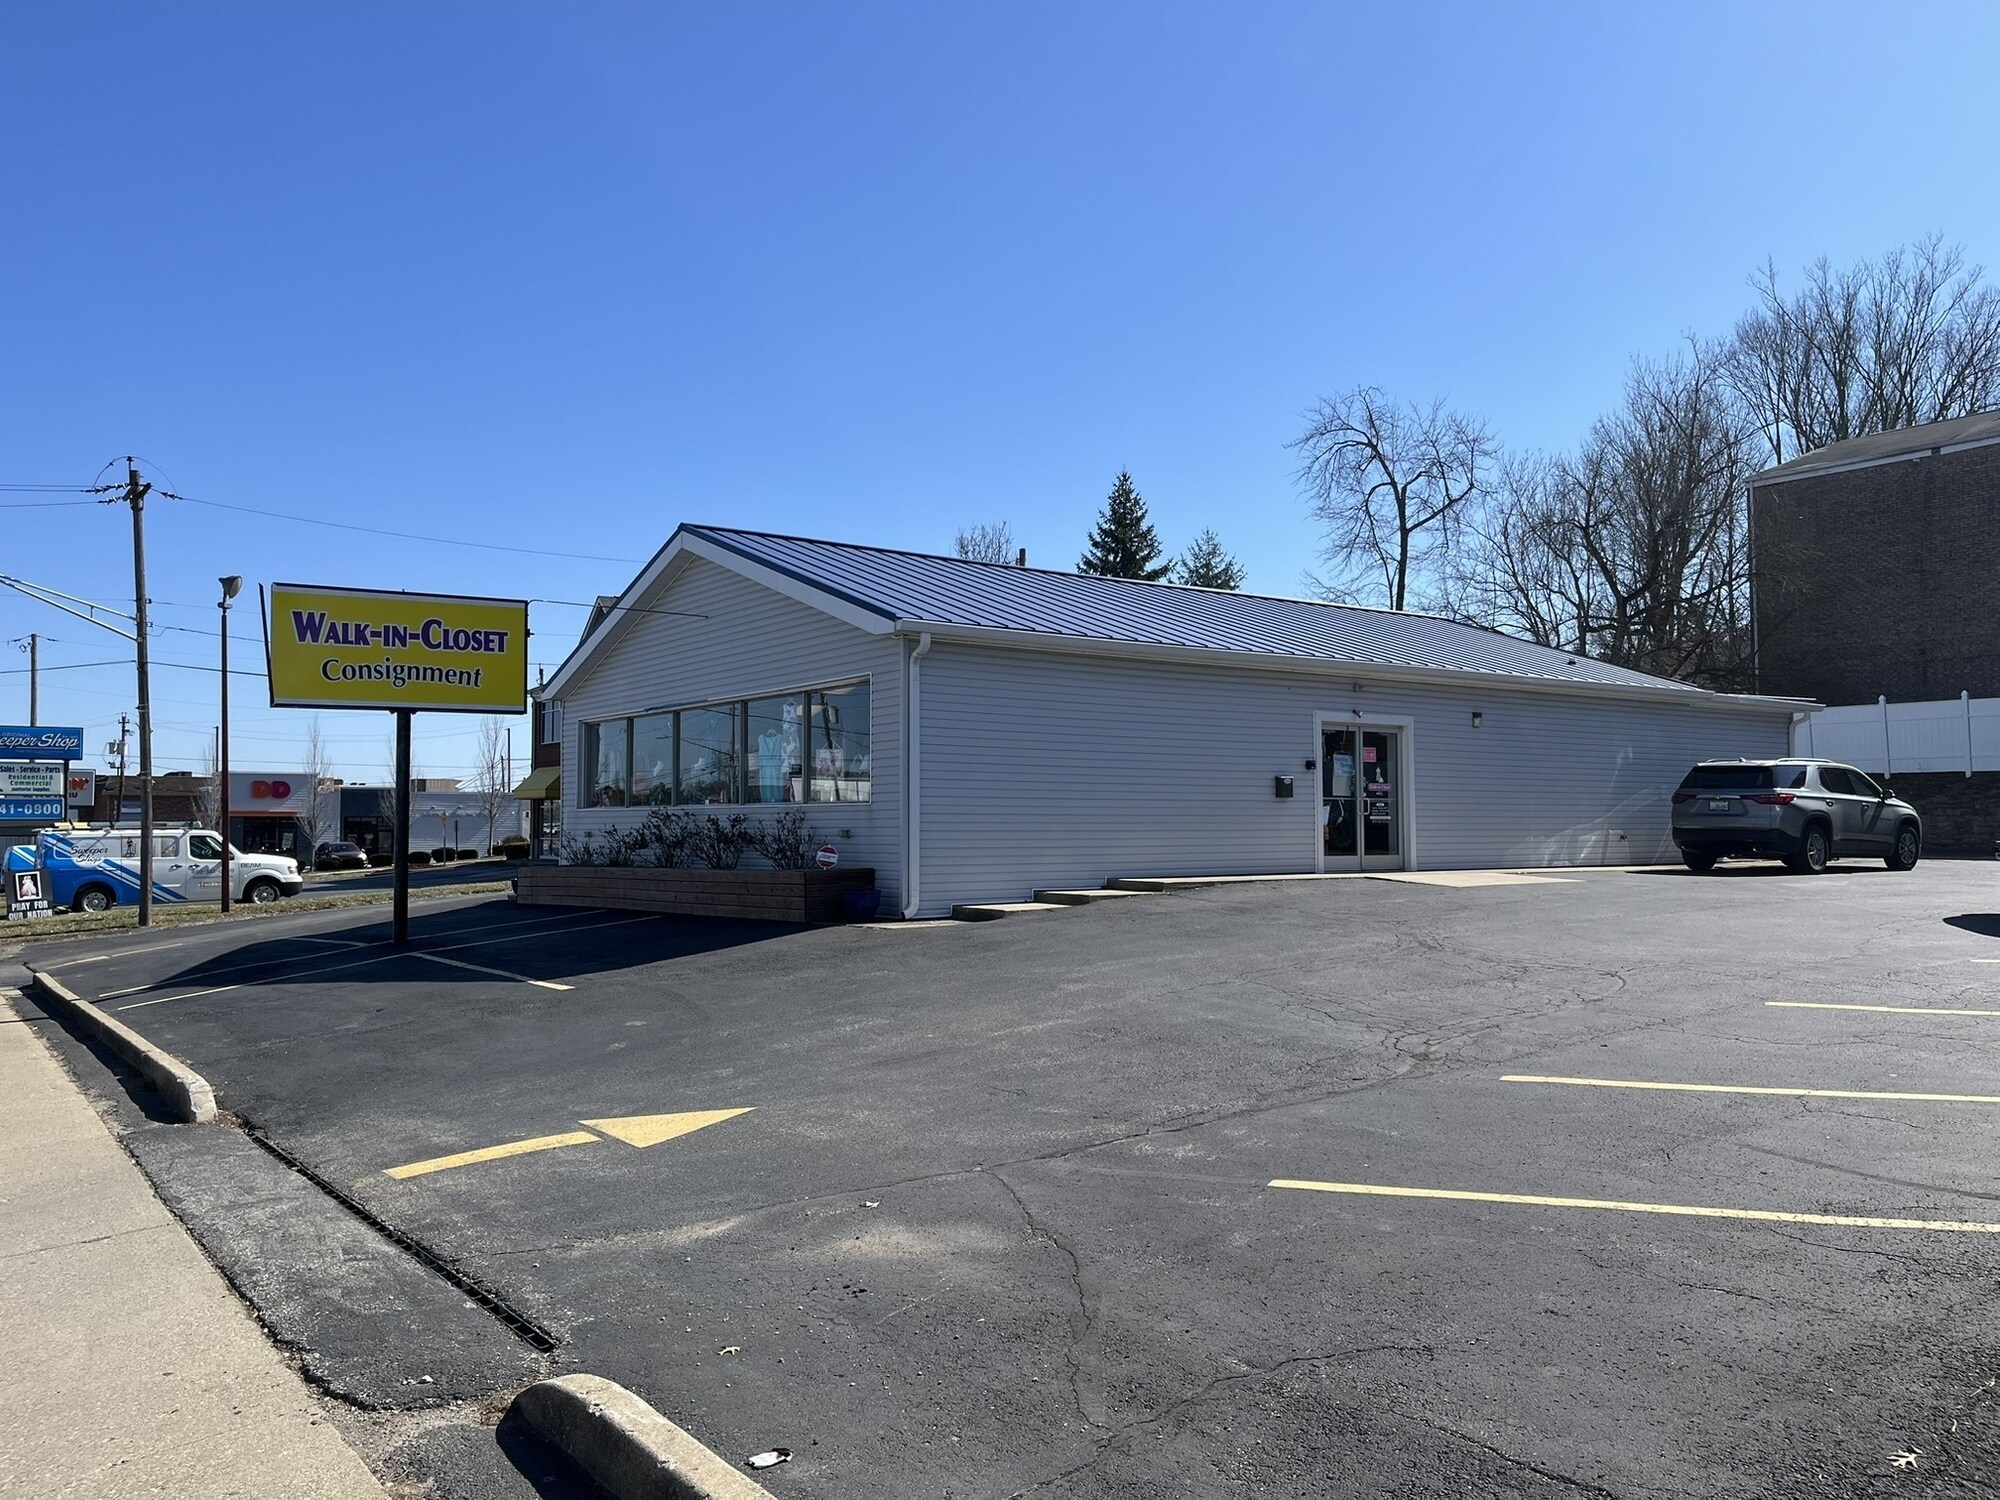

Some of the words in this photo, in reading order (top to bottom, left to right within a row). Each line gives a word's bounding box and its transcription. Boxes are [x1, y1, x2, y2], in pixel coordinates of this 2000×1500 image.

[320, 656, 483, 689] Consignment
[38, 733, 79, 750] Shop
[20, 765, 41, 773] Service
[70, 845, 109, 856] Sweeper
[76, 854, 101, 863] Shop
[11, 902, 31, 911] PRAY
[34, 900, 49, 909] FOR
[8, 912, 24, 920] OUR
[27, 909, 53, 919] NATION
